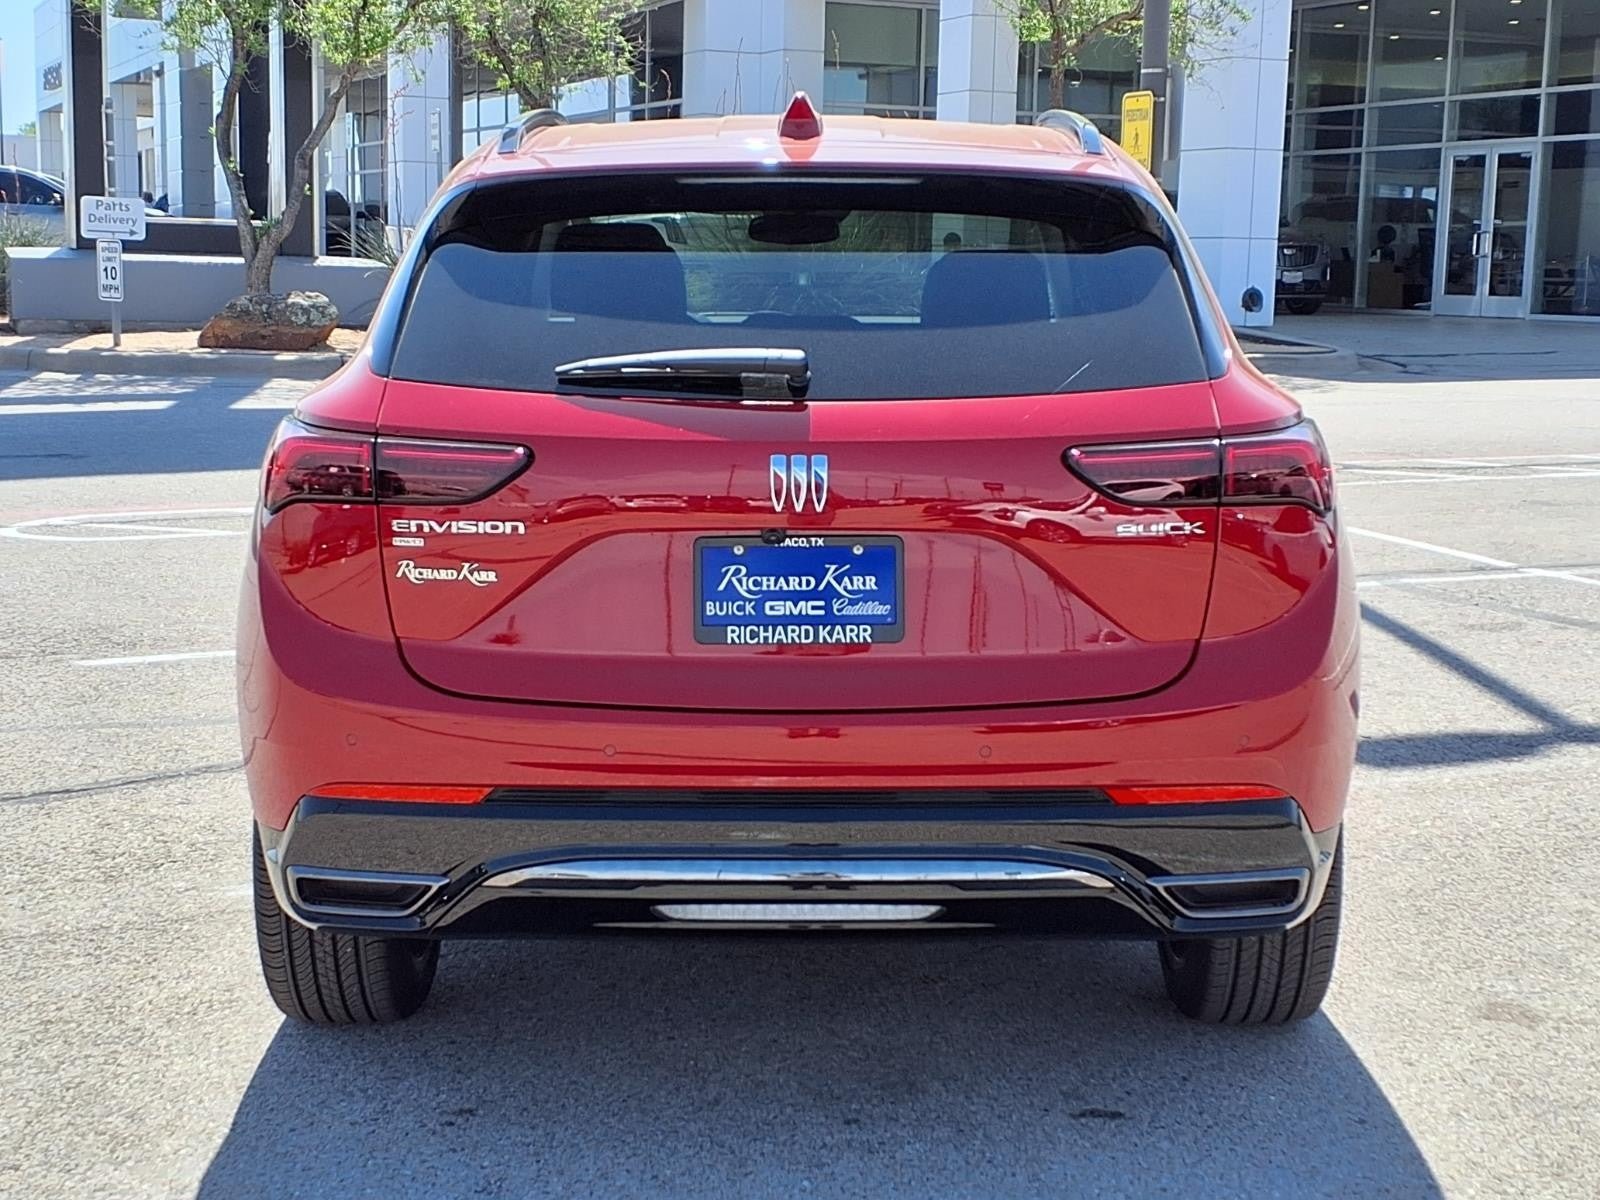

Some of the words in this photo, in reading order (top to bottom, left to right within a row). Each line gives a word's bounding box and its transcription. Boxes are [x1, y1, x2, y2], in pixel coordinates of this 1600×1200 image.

[95, 200, 131, 213] Parts
[88, 213, 138, 227] Delivery
[103, 266, 118, 280] 10
[102, 284, 120, 294] MPH
[392, 519, 526, 535] ENVISION
[1116, 522, 1206, 537] BUICK
[774, 537, 809, 548] ACO,
[396, 560, 458, 584] RICHARD
[458, 562, 498, 587] KARR
[717, 564, 816, 599] RICHARD
[817, 564, 878, 598] KARR
[706, 601, 756, 616] BUICK
[764, 600, 826, 616] GMC
[832, 598, 891, 616] Cadillac
[727, 625, 814, 643] RICHARD
[819, 625, 872, 644] KARR
